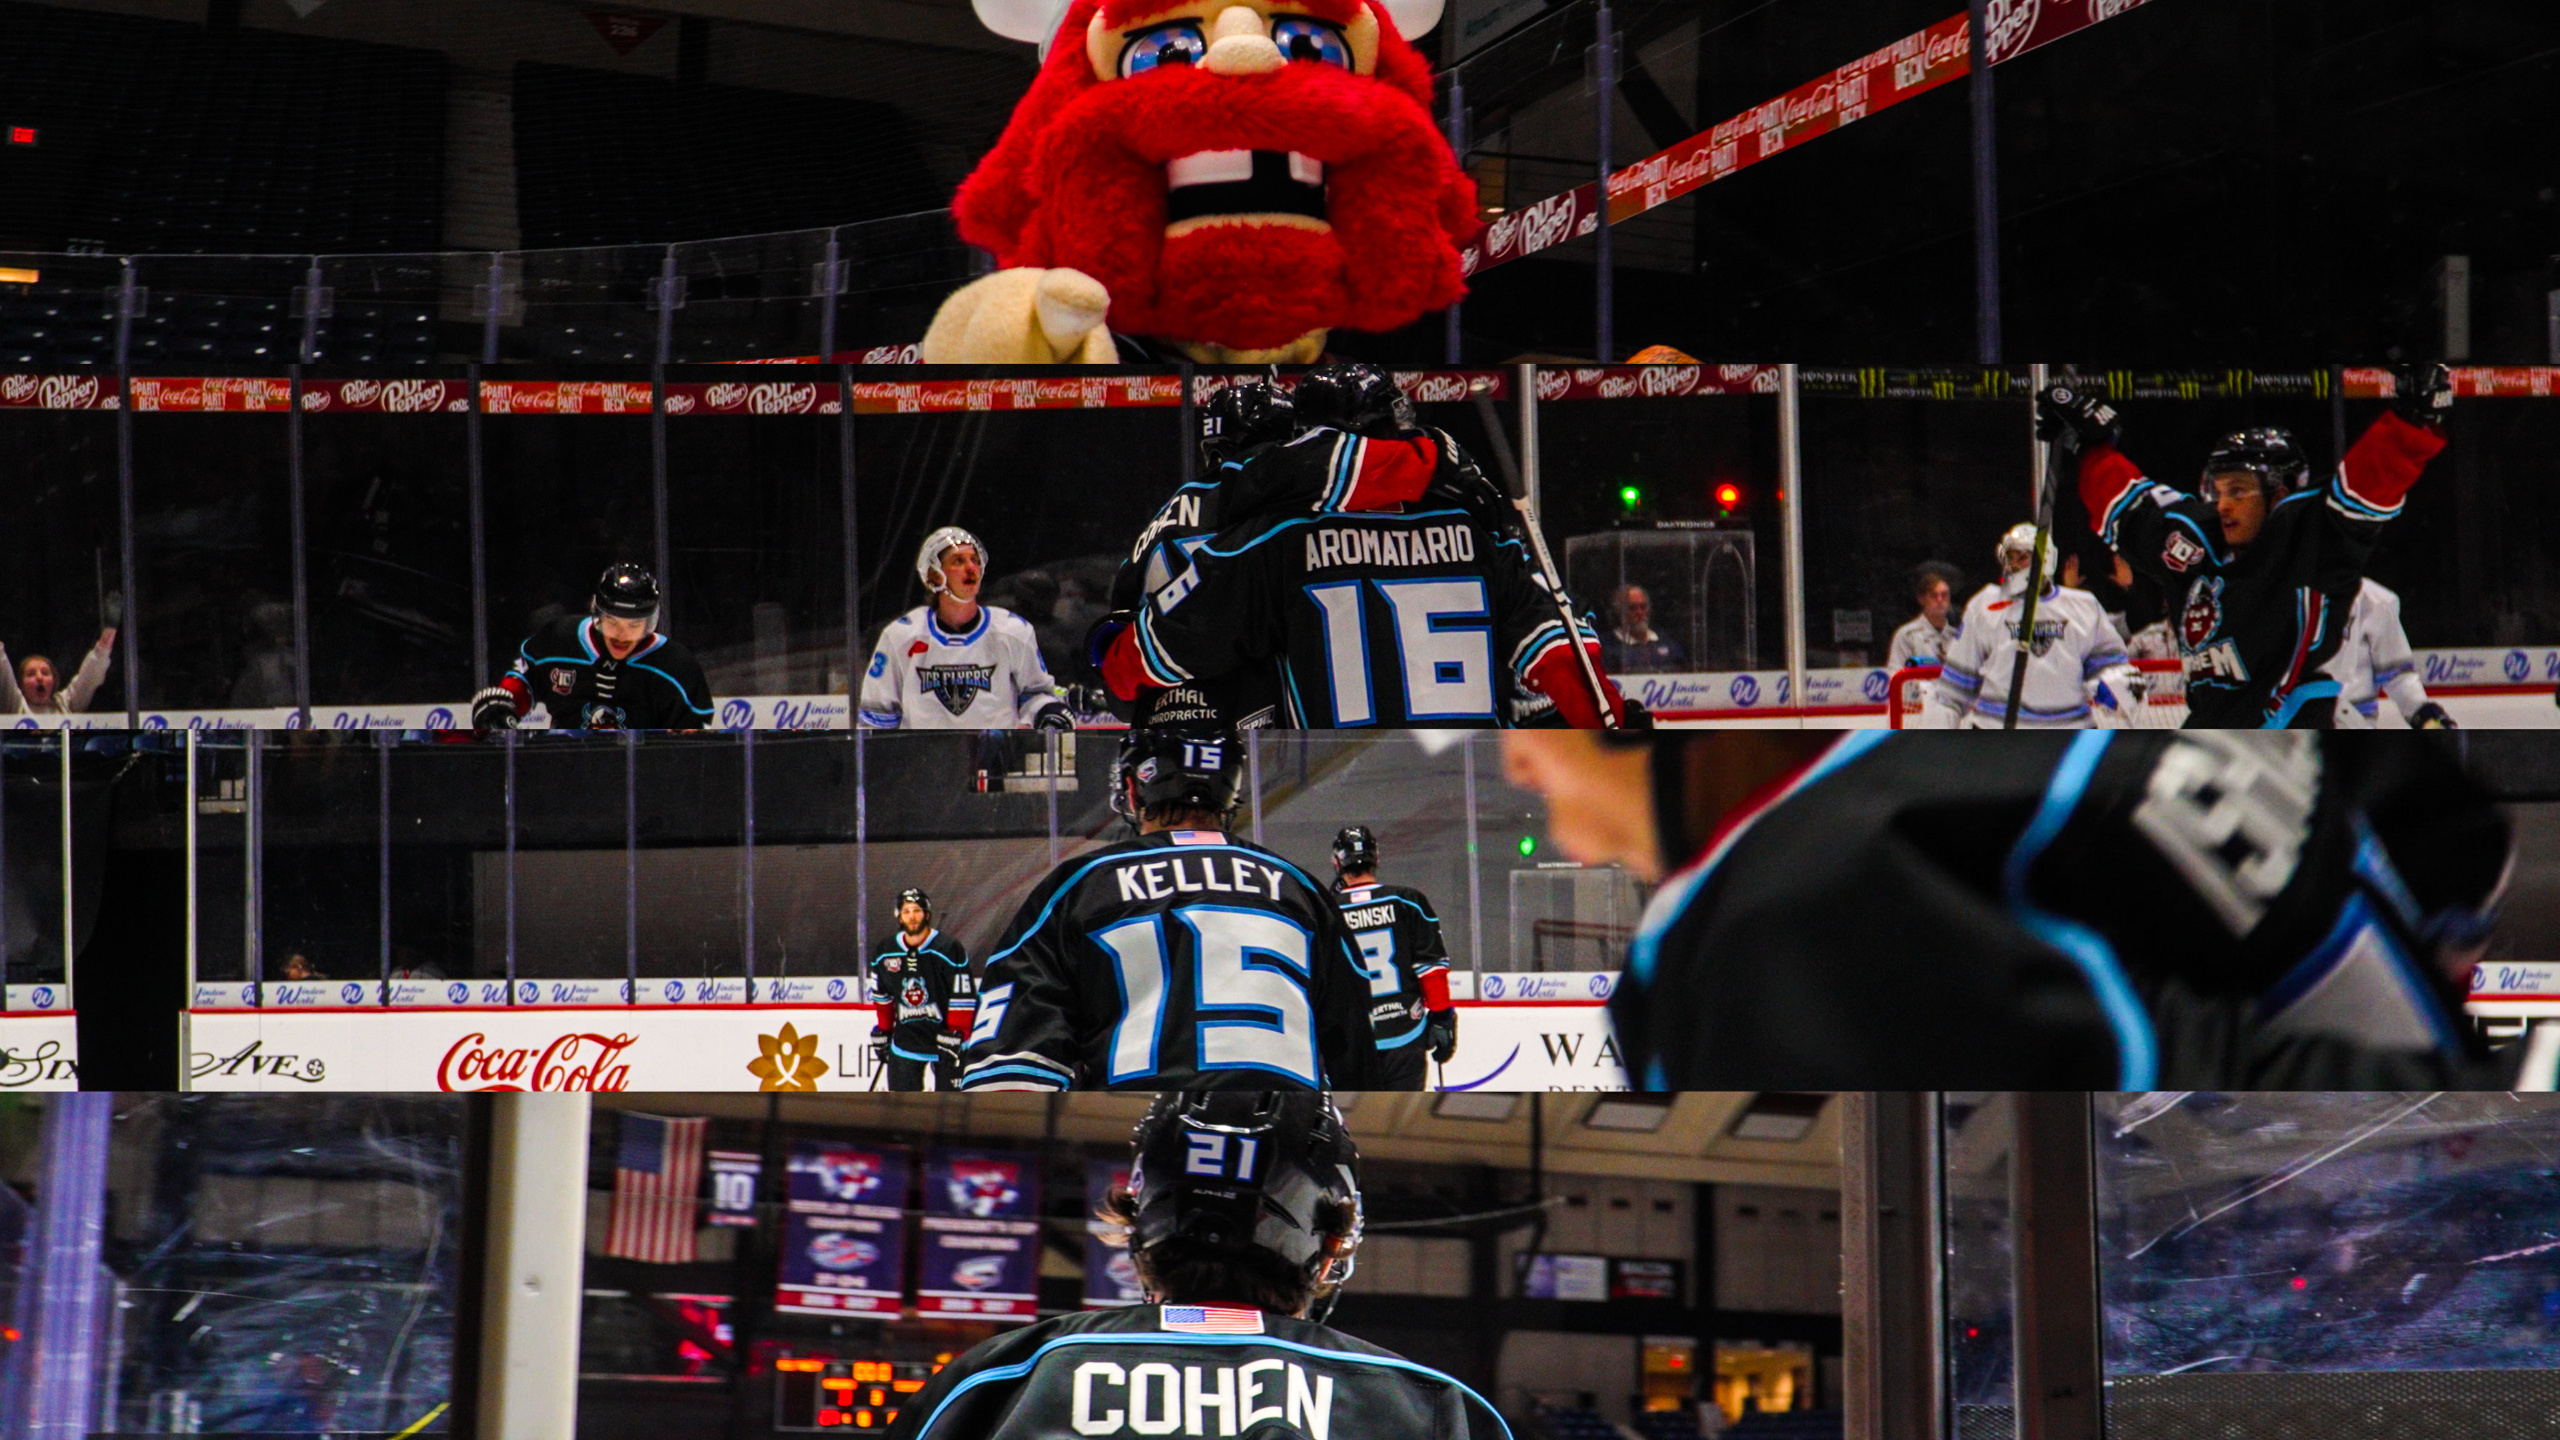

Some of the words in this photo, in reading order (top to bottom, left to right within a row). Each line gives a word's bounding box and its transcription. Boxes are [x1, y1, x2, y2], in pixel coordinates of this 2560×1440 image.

[1895, 52, 1926, 91] DECK
[1836, 73, 1869, 113] PARTY
[1756, 97, 1786, 134] PARTY
[1784, 80, 1837, 130] Coca-Cola
[1759, 124, 1785, 158] DECK
[2, 379, 38, 400] Pepper
[136, 381, 161, 396] PARTY
[244, 380, 268, 396] PARTY
[602, 383, 628, 398] PARTY
[895, 384, 921, 398] PARTY
[1012, 380, 1037, 394] PARTY
[1036, 382, 1082, 399] Coca-Cola
[1417, 379, 1464, 402] Pepper
[1433, 376, 1452, 388] Dr
[1643, 365, 1696, 396] Pepper
[41, 377, 94, 409] Pepper
[160, 388, 201, 406] Coca-Cola
[202, 392, 226, 408] PARTY
[341, 382, 379, 403] Pepper
[386, 381, 441, 412] Pepper
[486, 385, 512, 398] PARTY
[512, 391, 556, 408] Coca-Cola
[706, 384, 746, 409] Pepper
[750, 383, 811, 414] Pepper
[921, 390, 966, 407] Coca-Cola
[966, 394, 993, 408] PARTY
[1014, 394, 1037, 408] DECK
[1081, 385, 1107, 399] PARTY
[1127, 386, 1150, 401] DECK
[139, 397, 160, 411] DECK
[246, 397, 267, 411] DECK
[489, 398, 511, 413] DECK
[557, 396, 583, 410] PARTY
[604, 398, 627, 413] DECK
[898, 398, 921, 412] DECK
[1202, 416, 1223, 437] 21
[1304, 523, 1476, 573] AROMATARIO
[1302, 575, 1497, 729] 16
[869, 652, 887, 678] 3
[920, 669, 941, 690] ICE
[942, 666, 992, 690] FLYERS
[1154, 687, 1208, 712] ERTHAL
[1181, 743, 1223, 770] 15
[1115, 857, 1284, 901] KELLEY
[952, 974, 972, 994] 16
[1086, 903, 1316, 1091] 15
[437, 1033, 640, 1091] Coca-Cola
[1183, 1129, 1261, 1182] 21
[1071, 1358, 1334, 1440] COHEN
